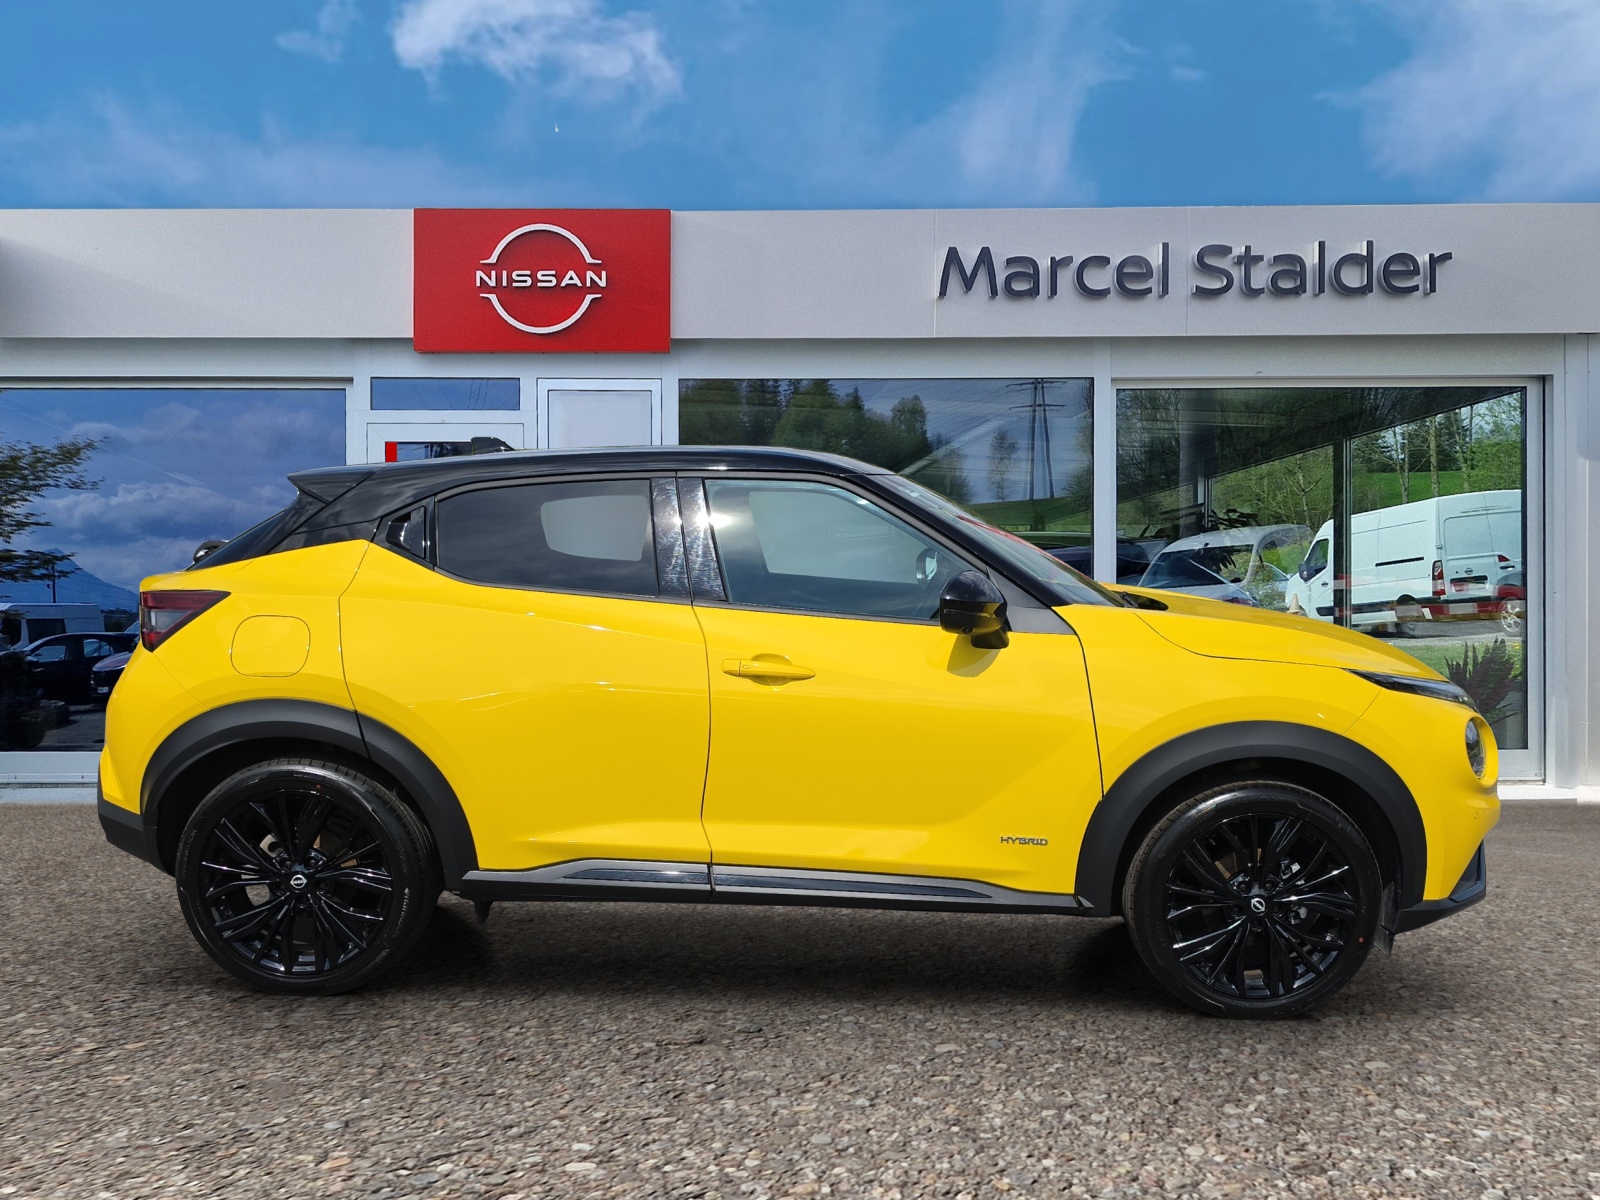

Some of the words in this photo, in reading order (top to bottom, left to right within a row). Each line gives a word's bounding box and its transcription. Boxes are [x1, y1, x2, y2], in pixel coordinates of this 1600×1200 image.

[938, 242, 1170, 299] Marcel
[1190, 239, 1453, 297] Stalder
[475, 270, 607, 288] NISSAN
[1000, 836, 1049, 847] HYBRID
